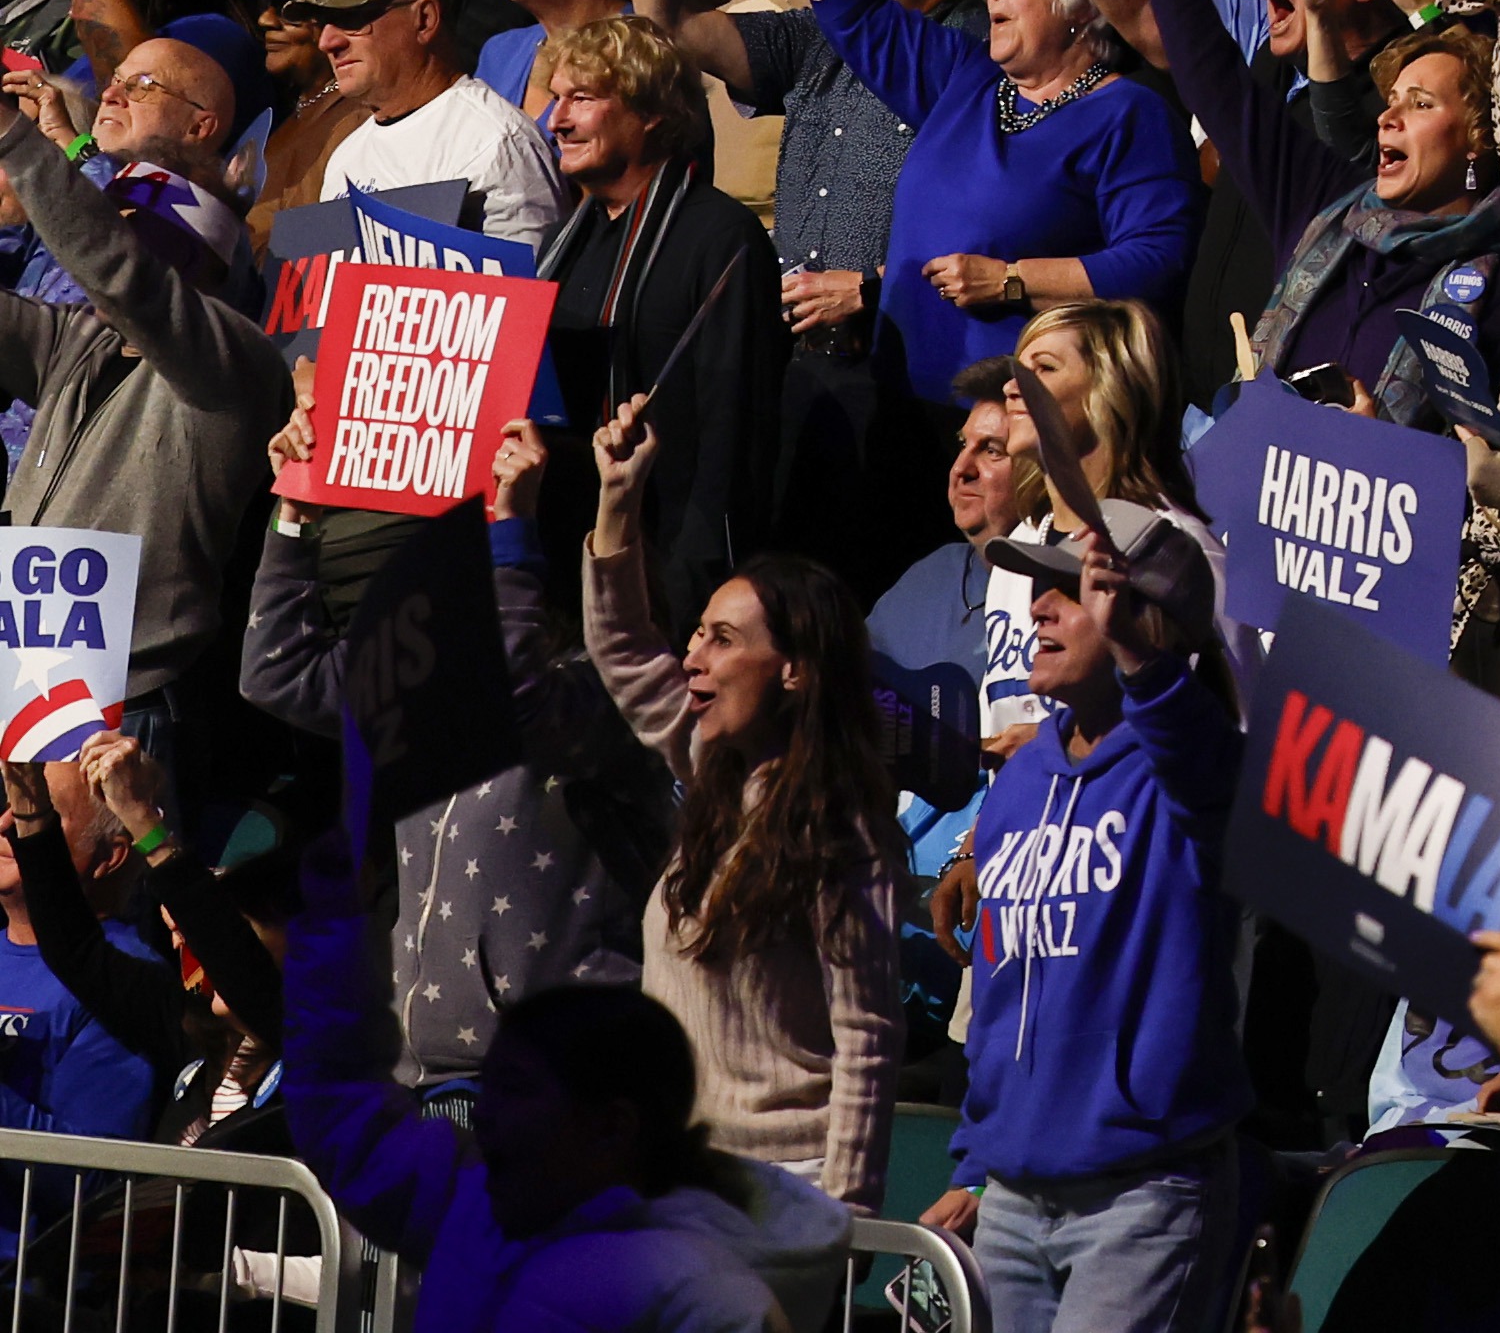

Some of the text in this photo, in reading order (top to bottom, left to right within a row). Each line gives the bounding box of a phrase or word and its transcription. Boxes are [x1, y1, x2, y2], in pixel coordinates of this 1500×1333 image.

[1448, 273, 1484, 288] LATINOS
[353, 283, 506, 363] FREEDOM
[340, 351, 485, 430] FREEDOM
[325, 418, 476, 499] FREEDOM
[1257, 444, 1417, 566] HARRIS
[11, 546, 110, 595] GO
[1274, 549, 1381, 613] WALZ
